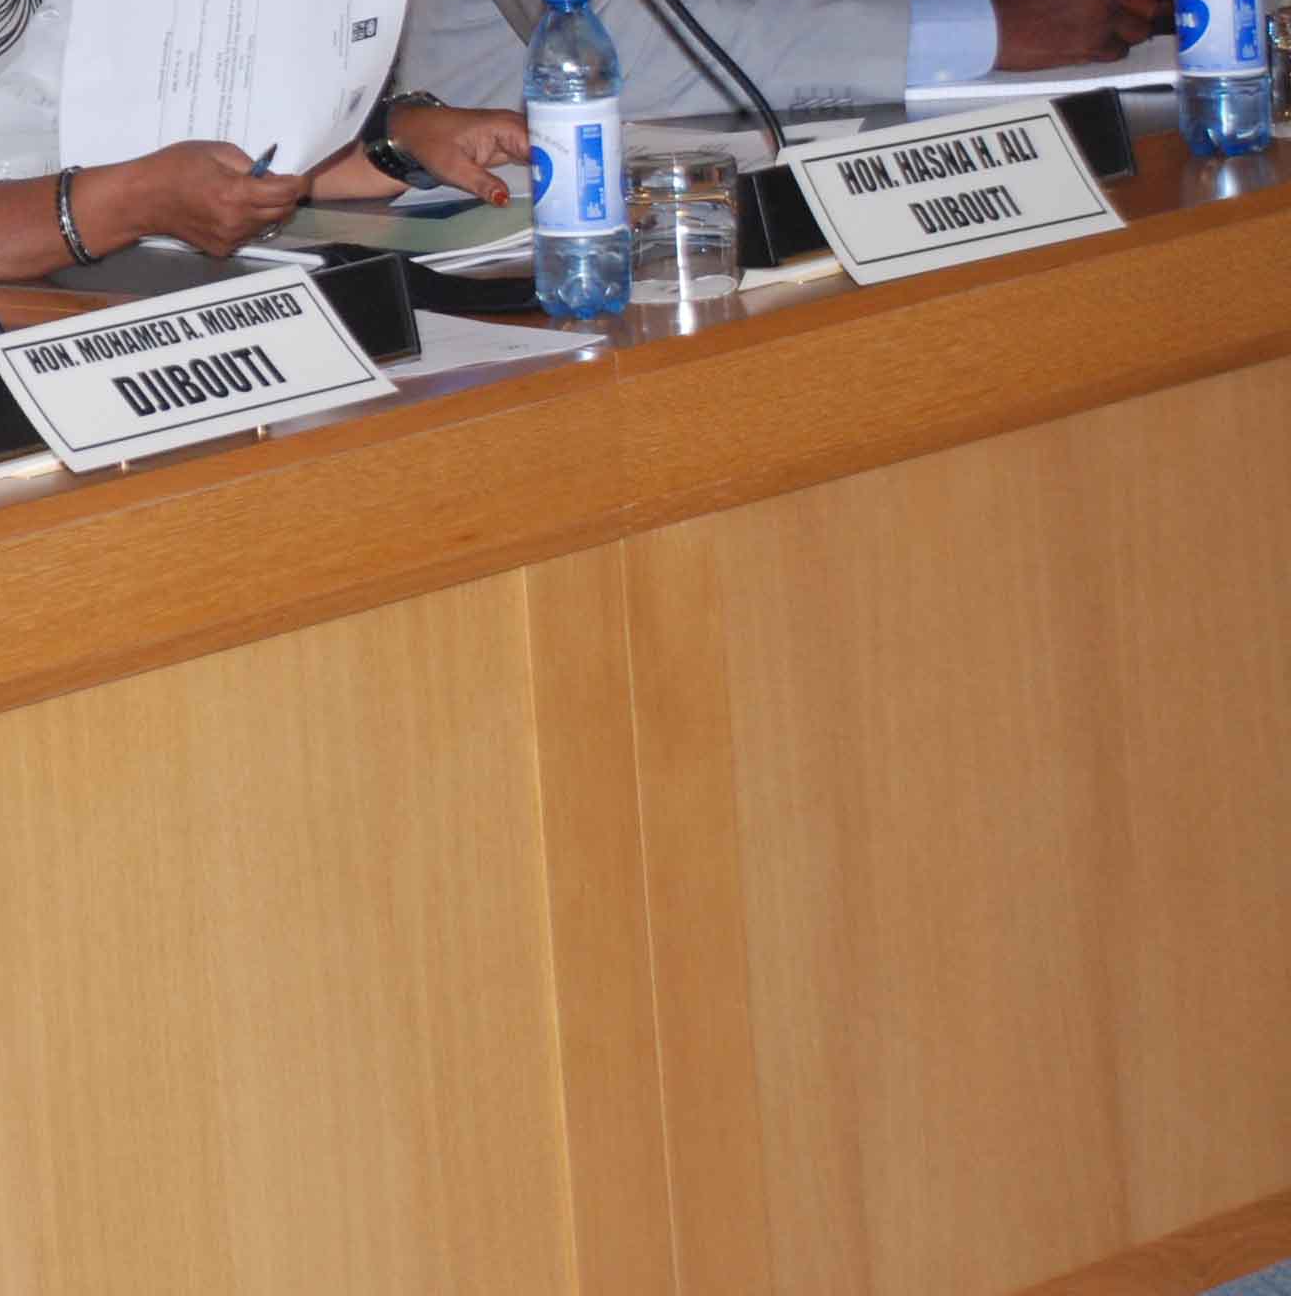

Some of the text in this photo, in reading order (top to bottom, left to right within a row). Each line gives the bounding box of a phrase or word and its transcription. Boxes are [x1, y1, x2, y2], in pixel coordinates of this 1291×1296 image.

[837, 127, 1039, 195] HON. HASNA H. ALI
[907, 185, 1021, 235] DJIBOUTI
[24, 292, 303, 375] HON. MOHAMED A. MOHAMED
[112, 345, 287, 417] DJIBOUTI
